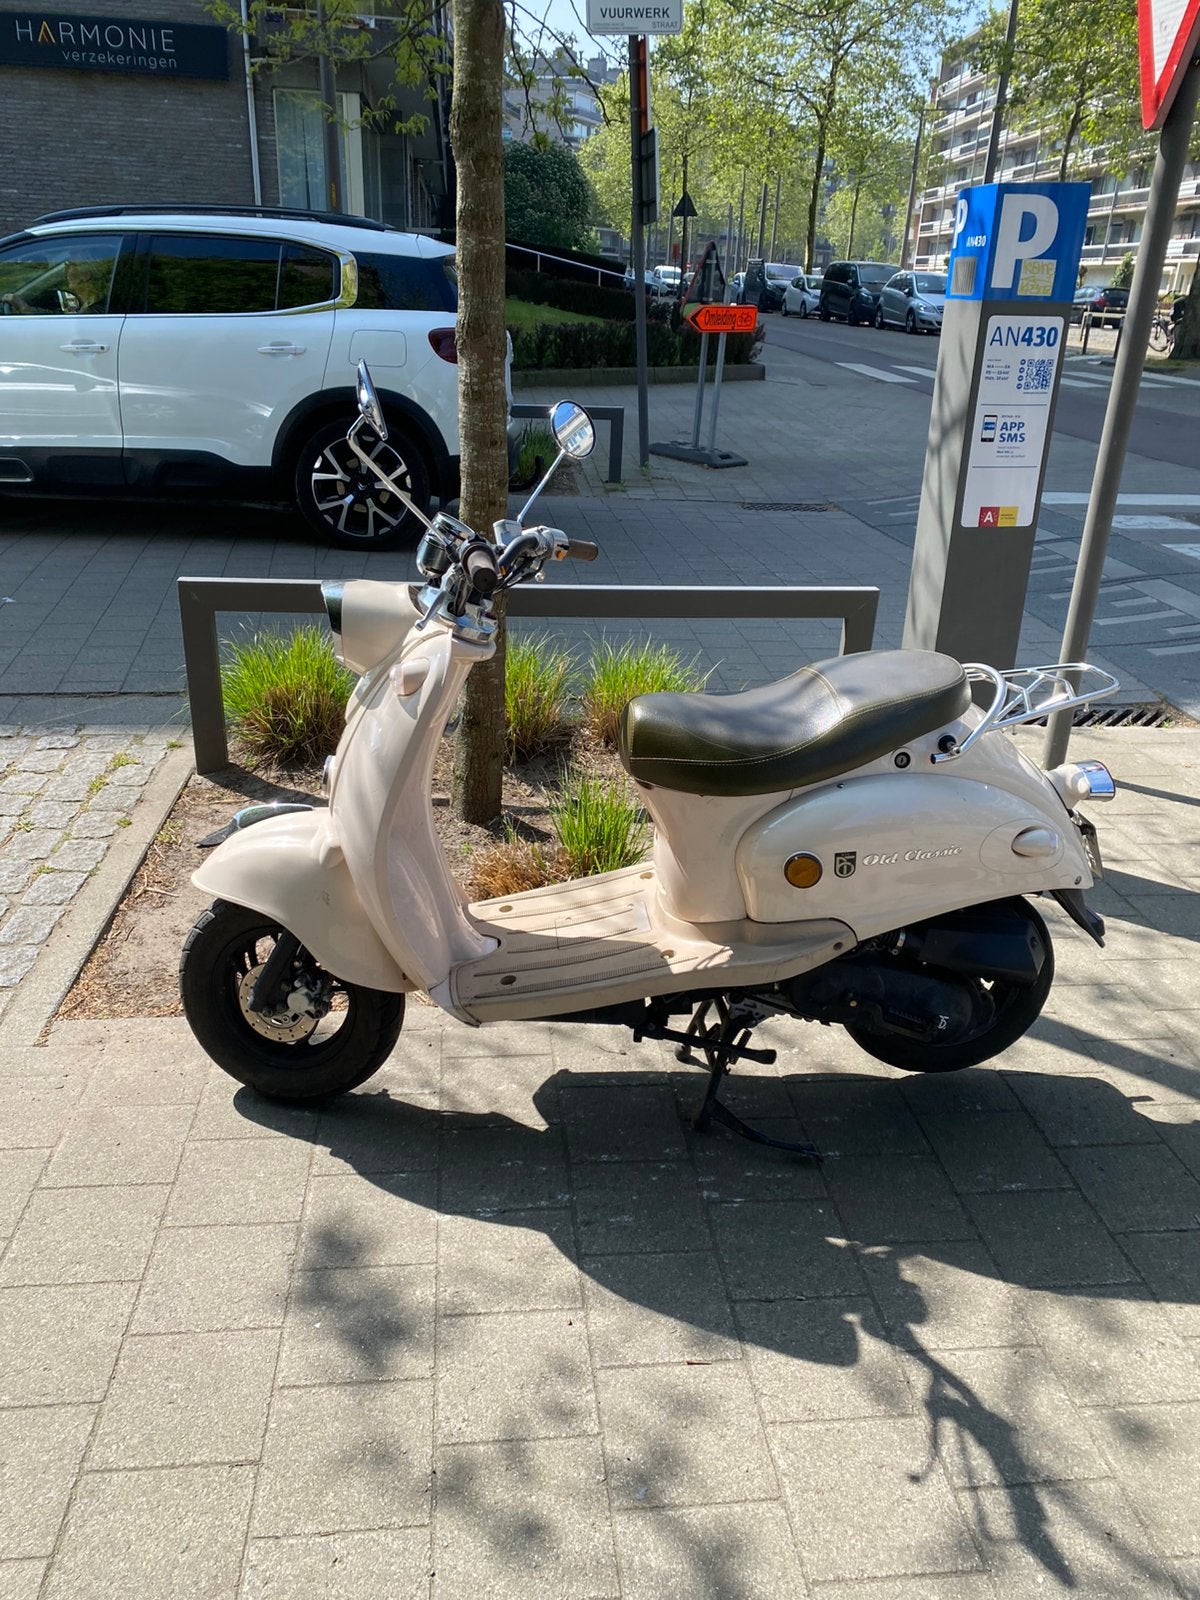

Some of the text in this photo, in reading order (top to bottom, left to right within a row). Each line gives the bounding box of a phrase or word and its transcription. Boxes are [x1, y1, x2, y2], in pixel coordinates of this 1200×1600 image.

[600, 7, 670, 19] VUURWERK
[15, 19, 176, 52] HARMONIE
[651, 21, 678, 29] STRAAT
[62, 49, 178, 70] verzekeringen
[952, 199, 968, 249] P
[966, 235, 987, 248] AN430
[991, 193, 1059, 288] P
[704, 309, 737, 330] Omleiding
[989, 326, 1059, 347] AN430
[1000, 422, 1025, 431] APP
[999, 433, 1026, 443] SMS
[862, 845, 962, 866] Old Classic
